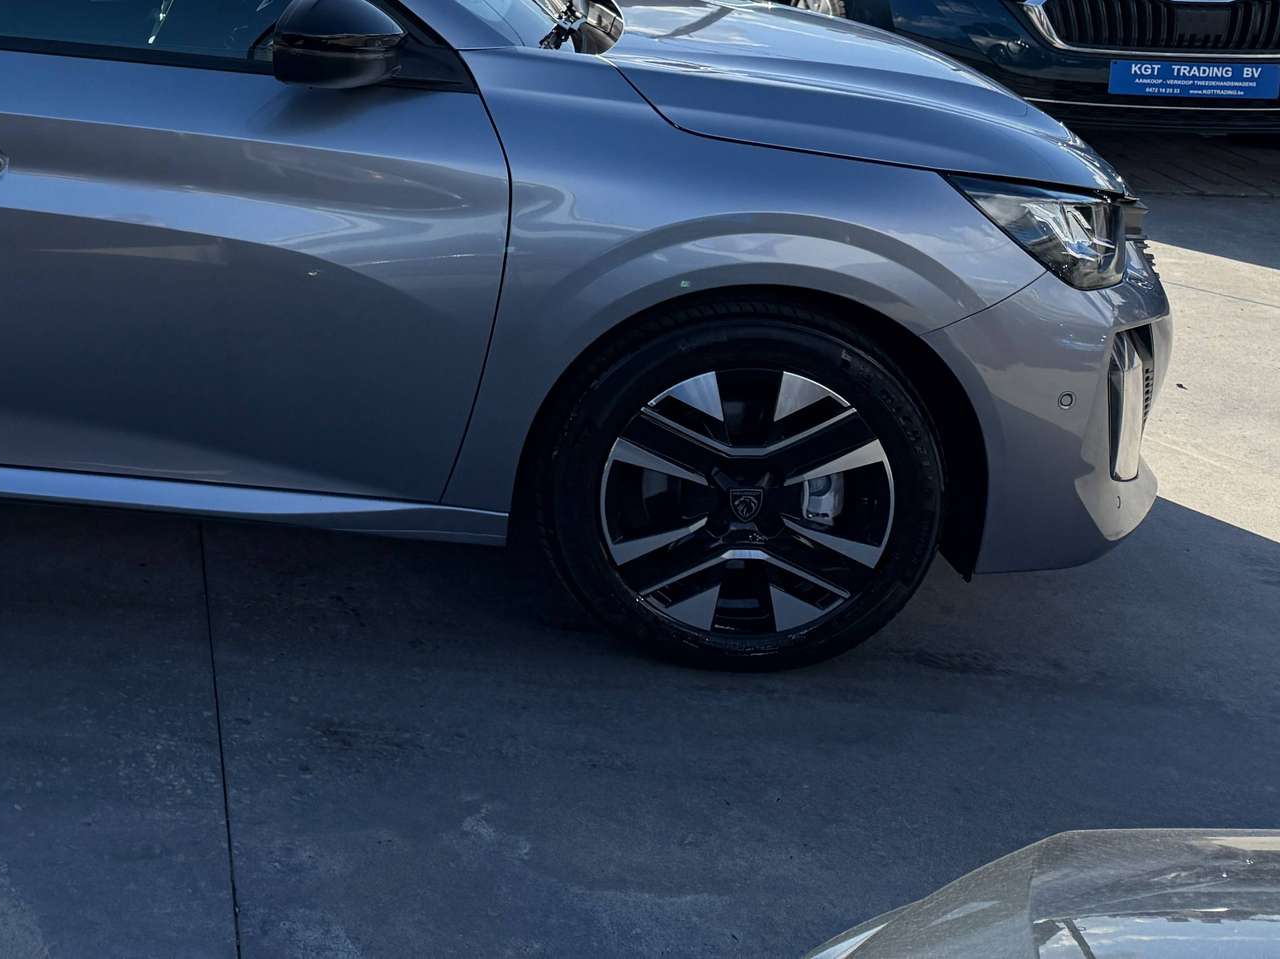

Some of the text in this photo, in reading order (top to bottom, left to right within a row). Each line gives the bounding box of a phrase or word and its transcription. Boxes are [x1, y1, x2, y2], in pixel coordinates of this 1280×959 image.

[1131, 63, 1262, 79] KGT TRADING BV
